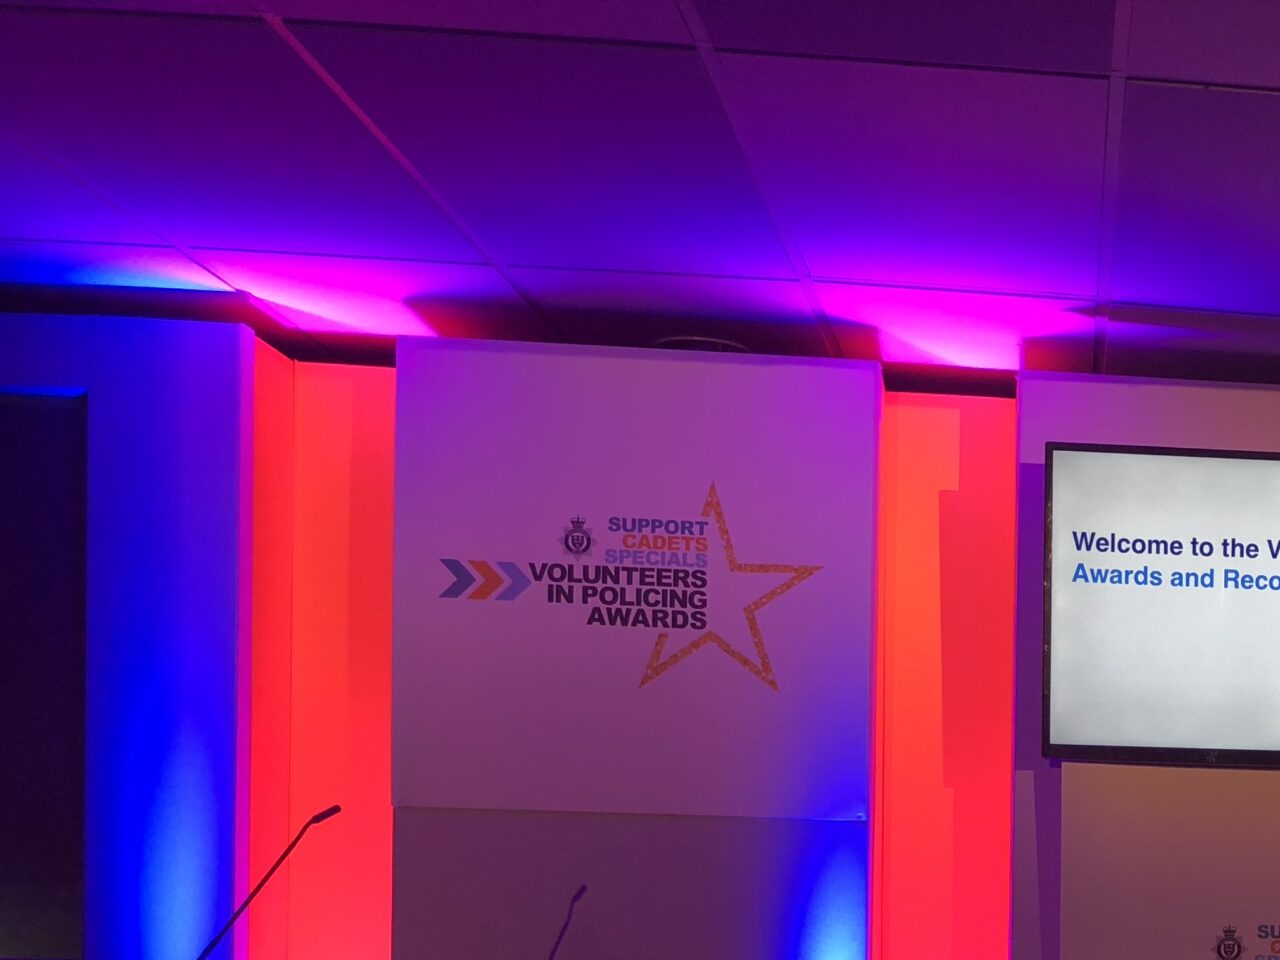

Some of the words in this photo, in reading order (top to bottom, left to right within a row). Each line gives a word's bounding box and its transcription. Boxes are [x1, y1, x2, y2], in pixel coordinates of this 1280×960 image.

[608, 517, 708, 536] SUPPORT
[622, 533, 708, 552] CADETS
[1072, 531, 1183, 556] Welcome
[1191, 537, 1214, 557] to
[1222, 538, 1259, 559] the
[604, 549, 708, 568] SPECIALS
[528, 562, 708, 588] VOLUNTEERS
[1072, 563, 1163, 586] Awards
[1170, 567, 1214, 588] and
[547, 584, 574, 604] IN
[582, 585, 708, 609] POLICING
[586, 607, 707, 630] AWARDS
